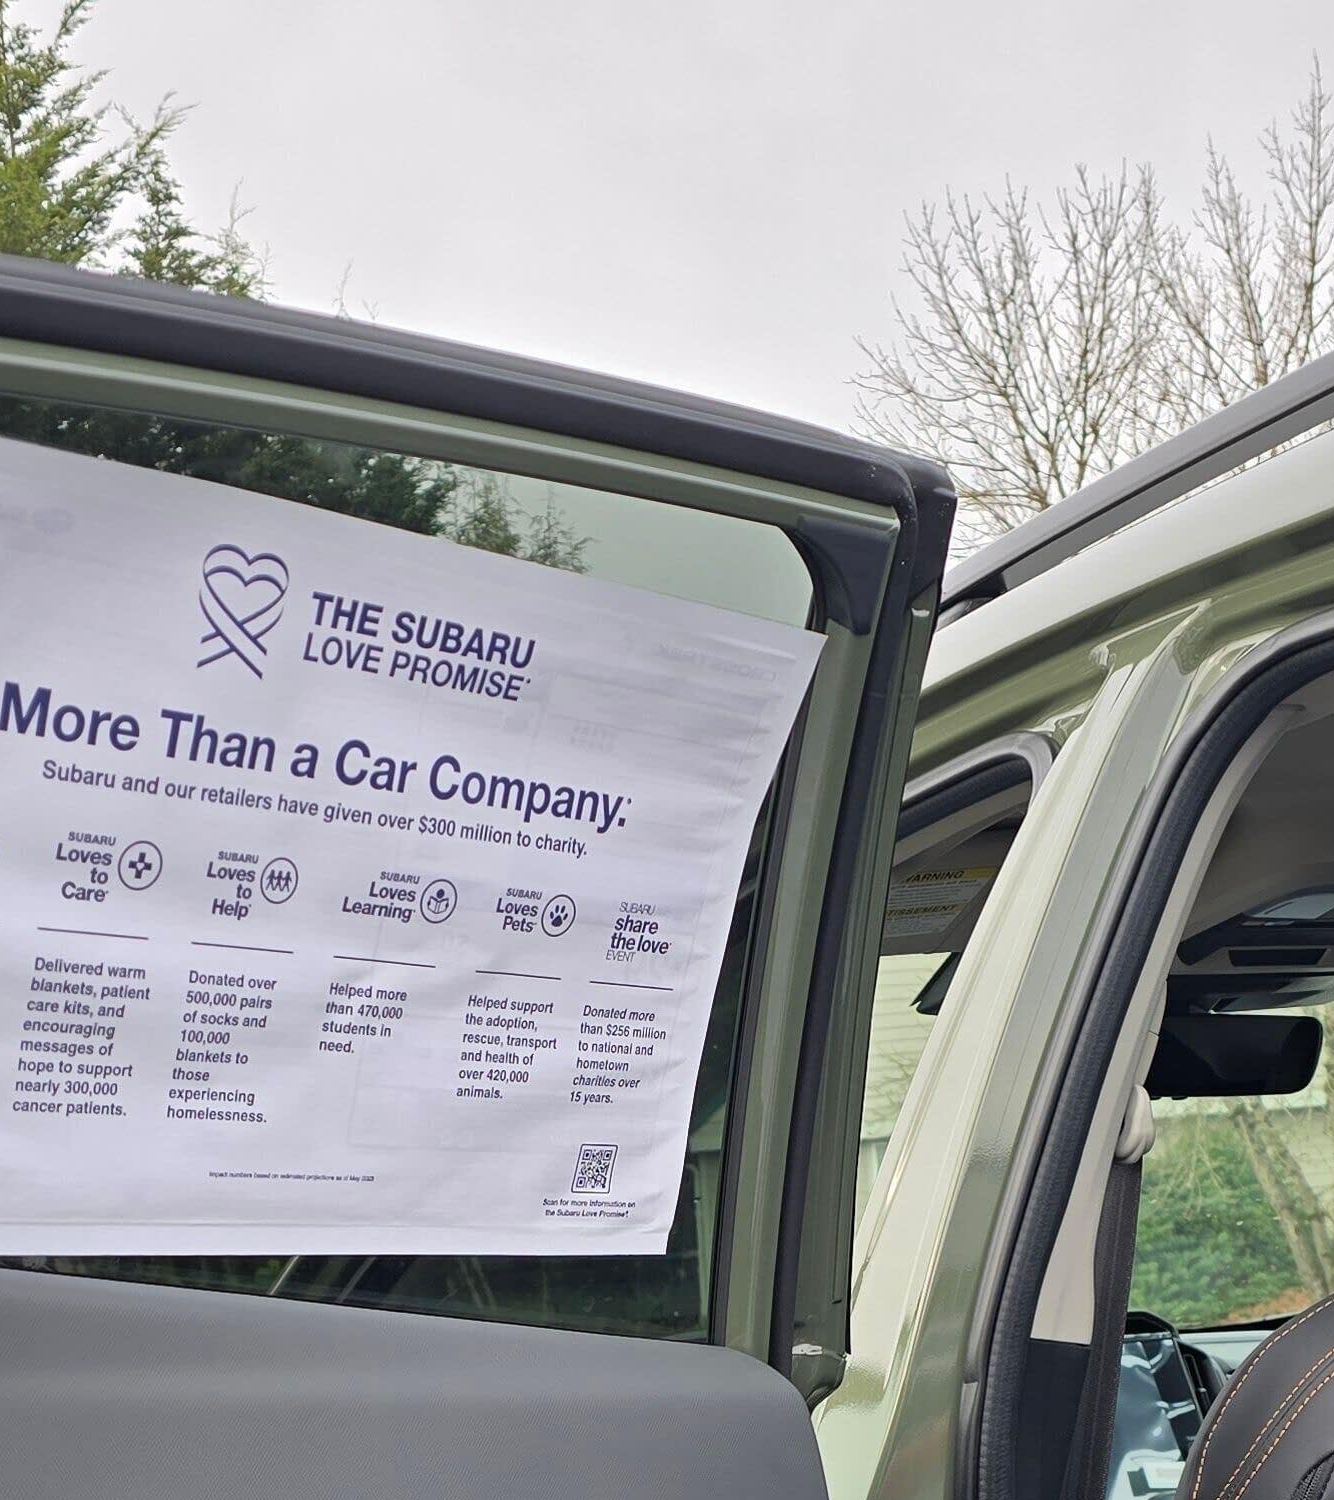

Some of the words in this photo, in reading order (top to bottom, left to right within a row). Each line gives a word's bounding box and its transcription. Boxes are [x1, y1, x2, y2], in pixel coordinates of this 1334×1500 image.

[312, 592, 383, 637] THE
[392, 612, 535, 668] SUBARU
[303, 632, 383, 674] LOVE
[0, 682, 140, 751] More
[161, 709, 275, 772] Than
[290, 744, 318, 779] a
[336, 740, 417, 793] Car
[43, 760, 116, 788] Subaru
[122, 776, 159, 795] and
[165, 783, 196, 799] our
[201, 787, 272, 810] retailers
[278, 794, 318, 816] have
[323, 803, 372, 824] given
[378, 814, 414, 830] over
[418, 816, 456, 837] $300
[460, 824, 512, 844] million
[517, 831, 531, 847] to
[536, 834, 586, 859] charity.
[68, 832, 116, 846] SUBARU
[56, 843, 113, 866] Loves
[218, 851, 259, 864] SUBARU
[90, 867, 108, 884] to
[207, 861, 256, 883] Loves
[380, 871, 420, 885] SUBARU
[236, 884, 252, 899] to
[369, 881, 416, 902] Loves
[506, 888, 542, 900] SUBARU
[496, 898, 538, 917] Loves
[621, 902, 656, 915] SUBARU
[615, 915, 658, 935] share
[611, 932, 635, 950] the
[606, 950, 634, 962] EVENT
[35, 957, 103, 976] Delivered
[108, 966, 145, 979] warm
[31, 977, 96, 998] blankets,
[101, 985, 150, 1000] patient
[189, 970, 244, 987] Donated
[248, 979, 277, 990] over
[186, 990, 237, 1006] 500,000
[240, 996, 272, 1010] pairs
[330, 983, 373, 999] Helped
[376, 990, 407, 1001] more
[27, 1001, 59, 1013] care
[63, 1000, 93, 1018] kits,
[97, 1005, 125, 1018] and
[326, 1002, 353, 1015] than
[357, 1004, 403, 1019] 470,000
[468, 995, 508, 1011] Helped
[510, 1001, 553, 1015] support
[583, 1005, 627, 1019] Donated
[628, 1012, 655, 1021] more
[183, 1010, 198, 1023] of
[200, 1013, 239, 1026] socks
[242, 1016, 267, 1028] and
[466, 1013, 483, 1026] the
[486, 1015, 537, 1032] adoption,
[23, 1020, 115, 1040] encouraging
[181, 1029, 230, 1045] 100,000
[322, 1021, 377, 1036] students
[380, 1024, 391, 1037] in
[581, 1022, 603, 1035] than
[606, 1024, 630, 1037] $256
[633, 1027, 666, 1039] million
[20, 1040, 94, 1057] messages
[99, 1043, 114, 1056] of
[319, 1041, 354, 1053] need.
[463, 1034, 503, 1046] rescue,
[507, 1035, 556, 1051] transport
[578, 1040, 588, 1051] to
[592, 1042, 633, 1054] national
[635, 1045, 654, 1055] and
[176, 1048, 231, 1063] blankets
[236, 1052, 248, 1064] to
[461, 1050, 482, 1062] and
[485, 1050, 519, 1064] health
[523, 1053, 534, 1065] of
[576, 1057, 629, 1071] hometown
[18, 1058, 54, 1075] hope
[59, 1061, 73, 1073] to
[77, 1064, 132, 1079] support
[172, 1067, 210, 1081] those
[459, 1070, 484, 1080] over
[487, 1069, 529, 1083] 420,000
[15, 1079, 60, 1096] nearly
[64, 1080, 118, 1096] 300,000
[573, 1074, 616, 1087] charities
[618, 1079, 640, 1088] over
[169, 1088, 255, 1106] experiencing
[456, 1085, 502, 1099] animals.
[571, 1091, 582, 1102] 15
[583, 1094, 613, 1105] years.
[13, 1101, 63, 1112] cancer
[66, 1101, 126, 1117] patients.
[167, 1105, 266, 1122] homelessness.
[543, 1198, 558, 1206] Scan
[590, 1199, 626, 1207] information
